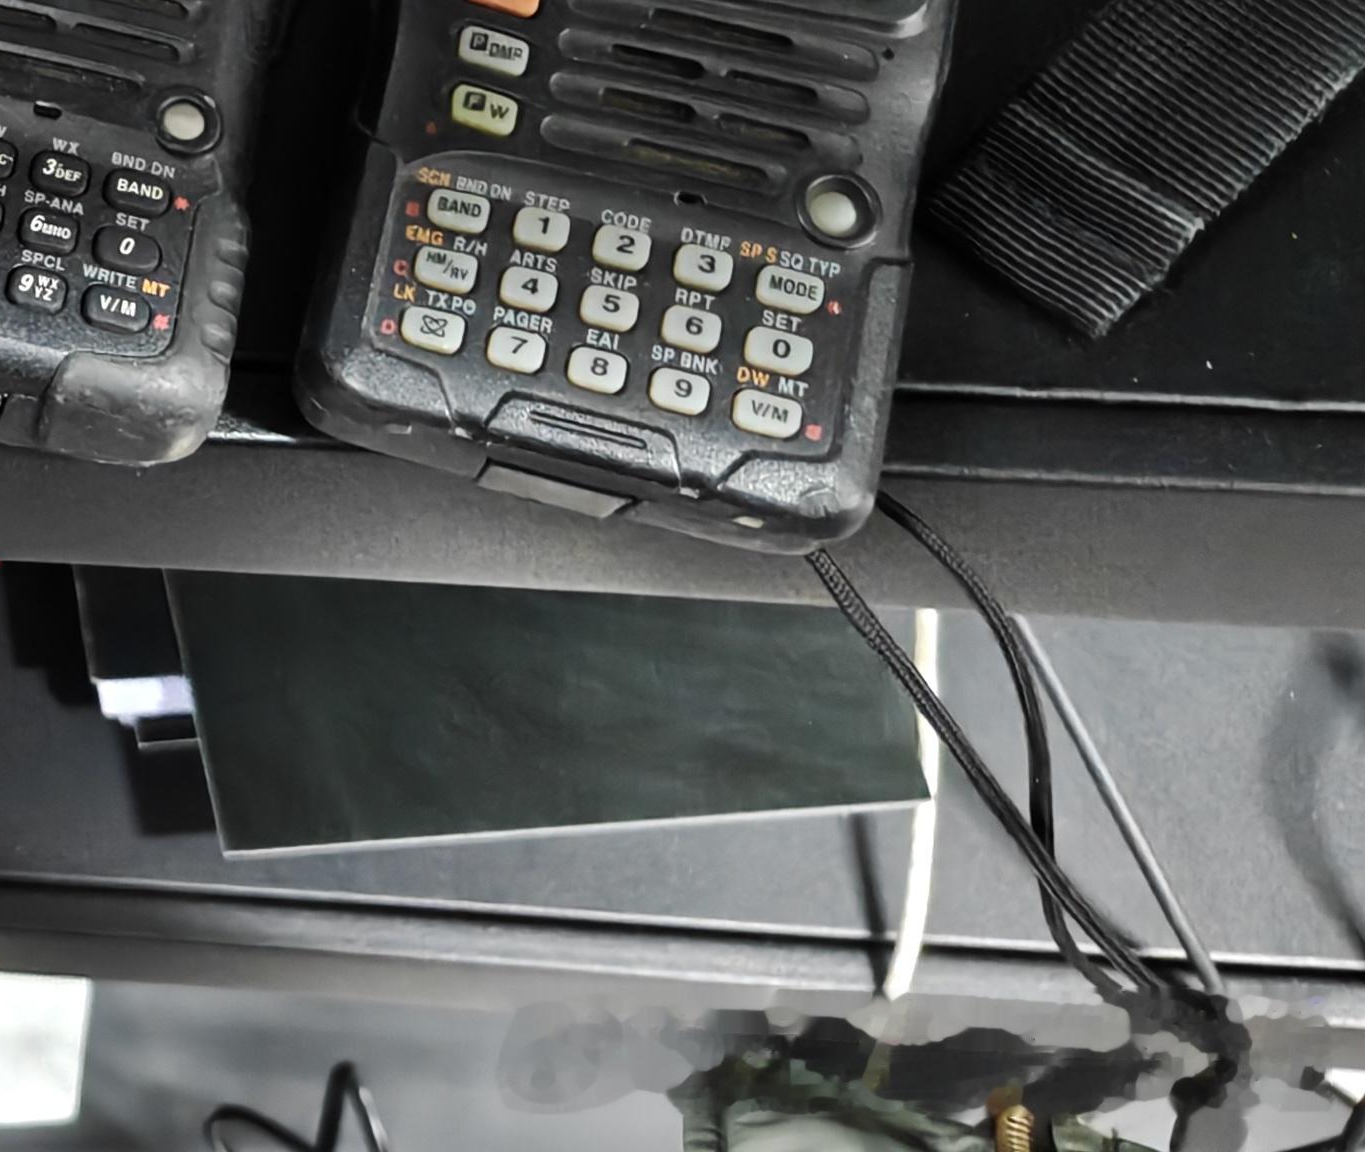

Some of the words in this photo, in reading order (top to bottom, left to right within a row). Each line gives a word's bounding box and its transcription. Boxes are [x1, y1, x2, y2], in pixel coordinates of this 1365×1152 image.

[53, 137, 80, 155] WX
[111, 152, 147, 171] BND
[150, 161, 176, 179] DN
[117, 178, 163, 200] BAND
[456, 176, 488, 195] BND
[490, 184, 512, 201] DN
[25, 191, 84, 216] SP-ANA
[437, 197, 482, 217] BAND
[524, 191, 570, 212] STEP
[116, 214, 150, 232] SET
[538, 216, 550, 234] 1
[601, 209, 652, 234] CODE
[119, 238, 135, 255] 0
[405, 224, 444, 246] EMG
[453, 237, 488, 256] R/H
[616, 235, 635, 254] 2
[680, 228, 731, 250] DTMF
[21, 250, 66, 272] SPCL
[426, 251, 469, 281] HM/RV
[509, 250, 558, 272] ARTS
[698, 256, 717, 274] 3
[739, 241, 762, 260] SP
[780, 251, 803, 269] SQ
[809, 257, 841, 278] TYP
[83, 264, 137, 289] WRITE
[142, 279, 170, 298] MT
[522, 278, 539, 295] 4
[590, 267, 637, 290] SKIP
[769, 275, 818, 300] MODE
[100, 295, 136, 317] V/M
[393, 284, 416, 303] LK
[426, 290, 449, 309] TX
[452, 297, 477, 315] PO
[602, 295, 621, 313] 5
[675, 288, 716, 310] RPT
[493, 306, 553, 334] PAGER
[685, 317, 703, 336] 6
[761, 310, 802, 332] SET
[510, 337, 528, 354] 7
[586, 329, 619, 350] EAI
[772, 340, 791, 358] 0
[591, 358, 609, 377] 8
[651, 346, 675, 362] SP
[680, 353, 718, 374] BNK
[674, 379, 692, 398] 9
[737, 367, 770, 388] DW
[778, 377, 809, 398] MT
[751, 400, 789, 424] V/M
